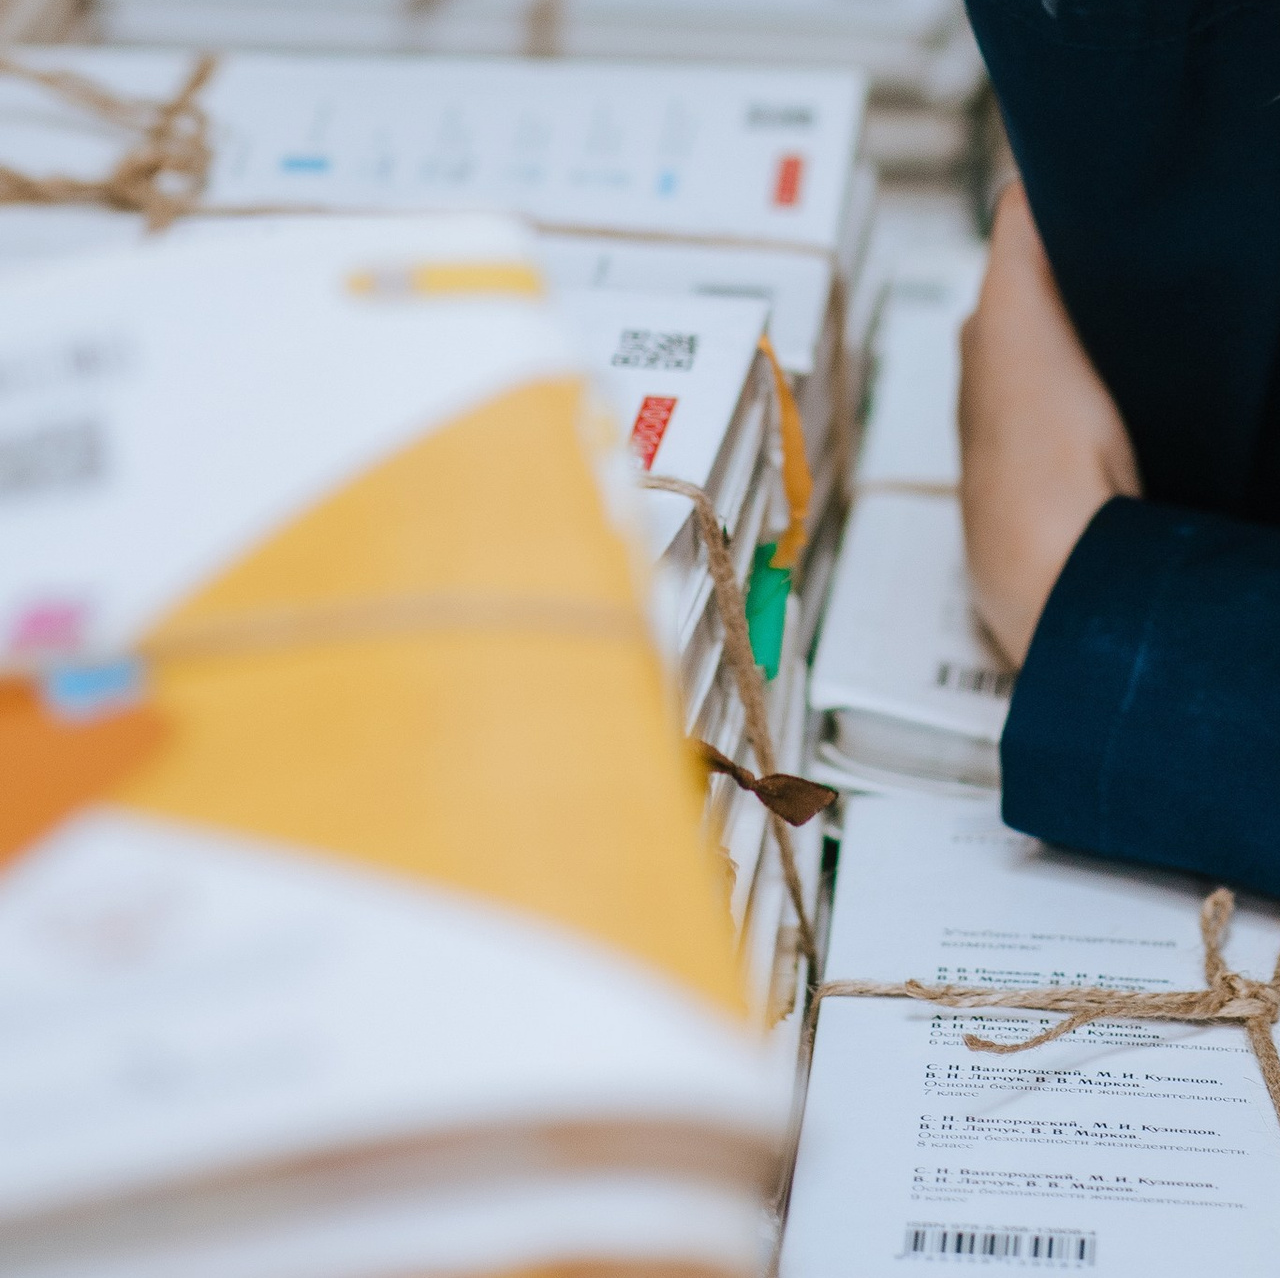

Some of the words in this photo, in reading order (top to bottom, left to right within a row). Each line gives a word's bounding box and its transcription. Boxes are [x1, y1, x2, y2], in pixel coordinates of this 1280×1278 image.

[968, 1073, 1030, 1083] Латчук,
[970, 1065, 1087, 1078] Вангородский,
[1122, 1072, 1139, 1080] И.
[1145, 1074, 1223, 1086] Кузнецов,
[924, 1080, 985, 1089] Основы
[990, 1083, 1093, 1094] безопасности
[1097, 1090, 1252, 1104] жизнедеятельности.
[920, 1114, 937, 1122] С.
[965, 1116, 1083, 1128] Вангородский,
[1093, 1122, 1114, 1130] М.
[1119, 1123, 1136, 1131] И.
[1142, 1125, 1222, 1137] Кузнецов,
[963, 1124, 1026, 1134] Латчук,
[918, 1131, 979, 1140] Основы
[984, 1135, 1089, 1145] безопасности
[1093, 1141, 1250, 1155] жизнедеятельности.
[914, 1166, 931, 1174] С.
[936, 1167, 954, 1175] Н.
[959, 1168, 1079, 1181] Вангородский,
[1115, 1176, 1132, 1184] И.
[1138, 1177, 1219, 1190] Кузнецов,
[1048, 1181, 1064, 1189] В.
[912, 1184, 973, 1194] Основы
[978, 1188, 1085, 1199] безопасности
